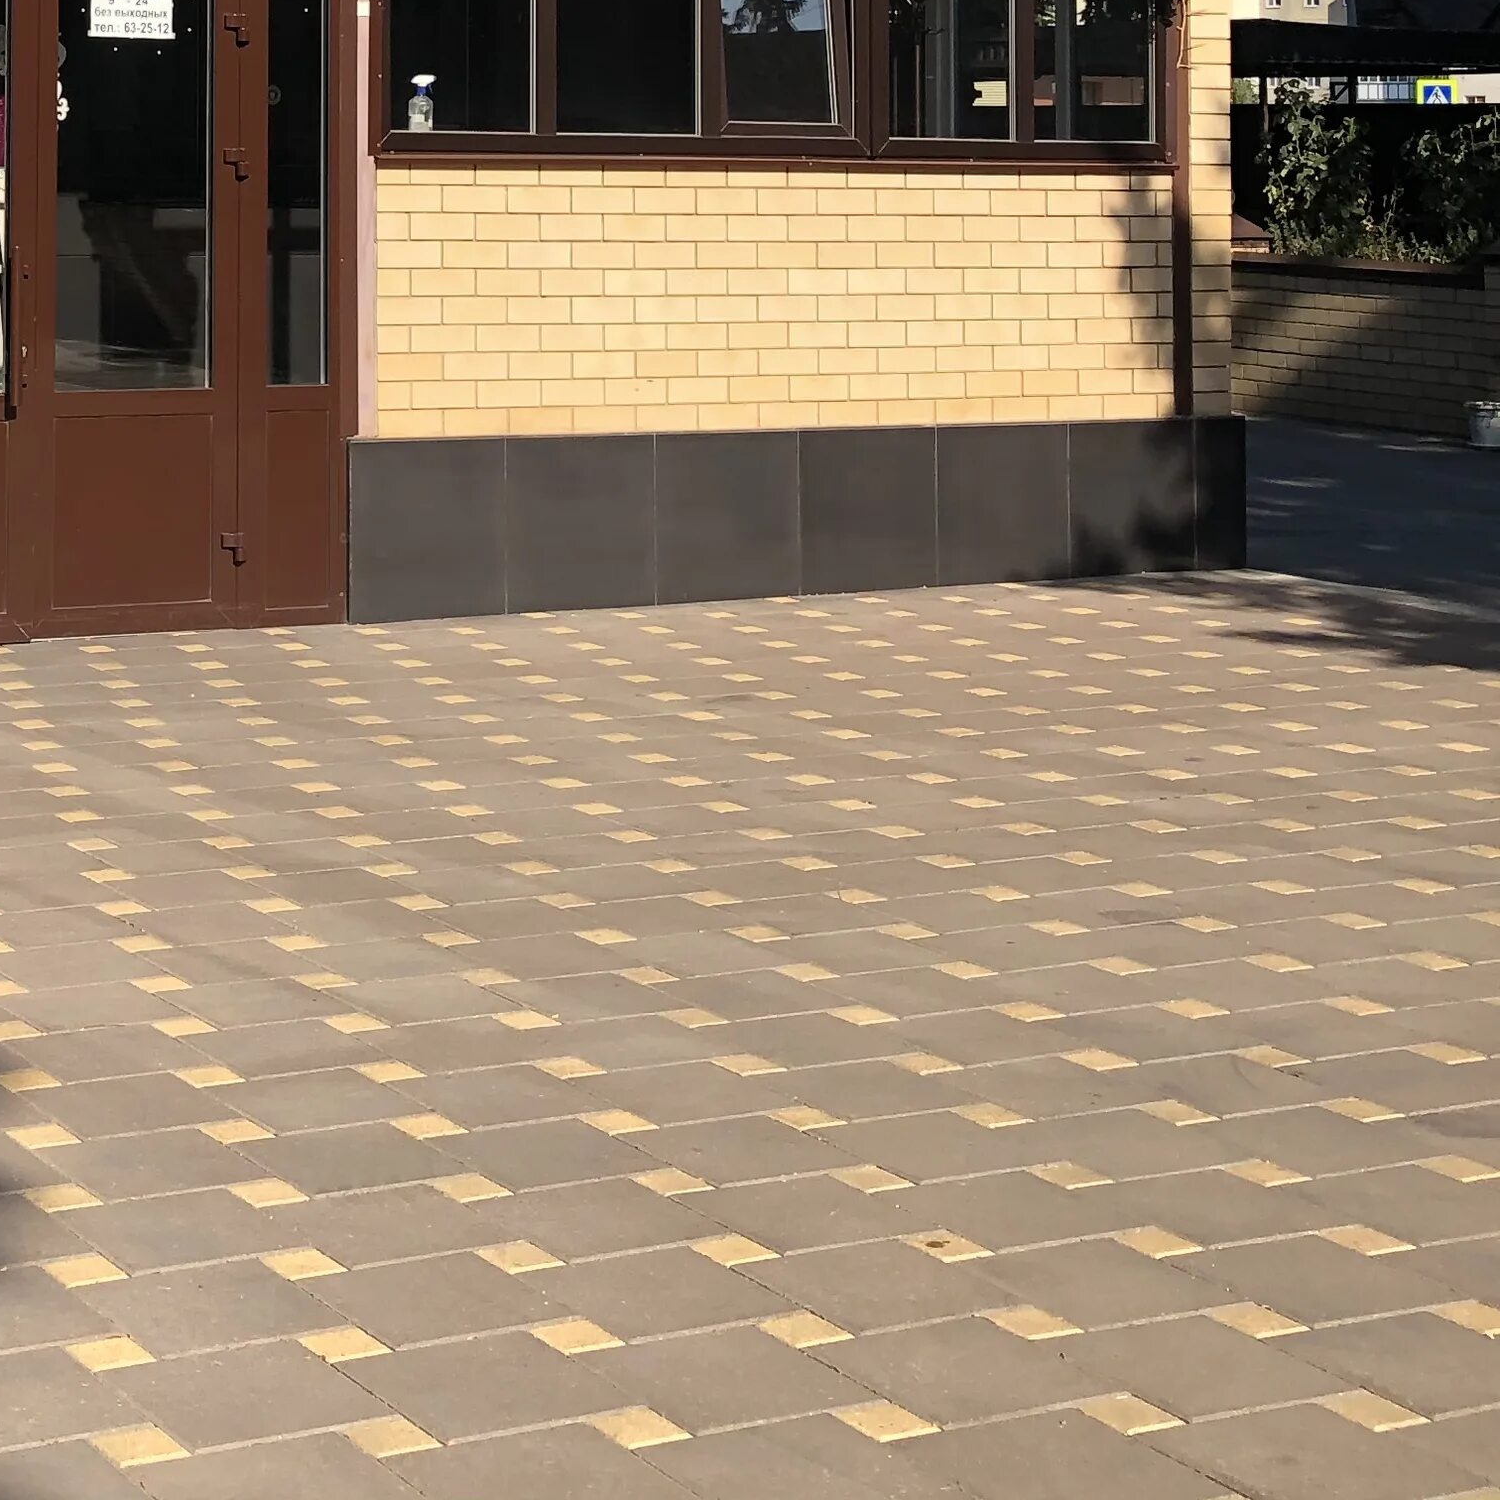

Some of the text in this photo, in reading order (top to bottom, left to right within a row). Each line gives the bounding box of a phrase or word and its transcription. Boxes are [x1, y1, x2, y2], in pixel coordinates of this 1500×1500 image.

[94, 6, 168, 19] без выходных
[124, 22, 170, 34] 63-25-12
